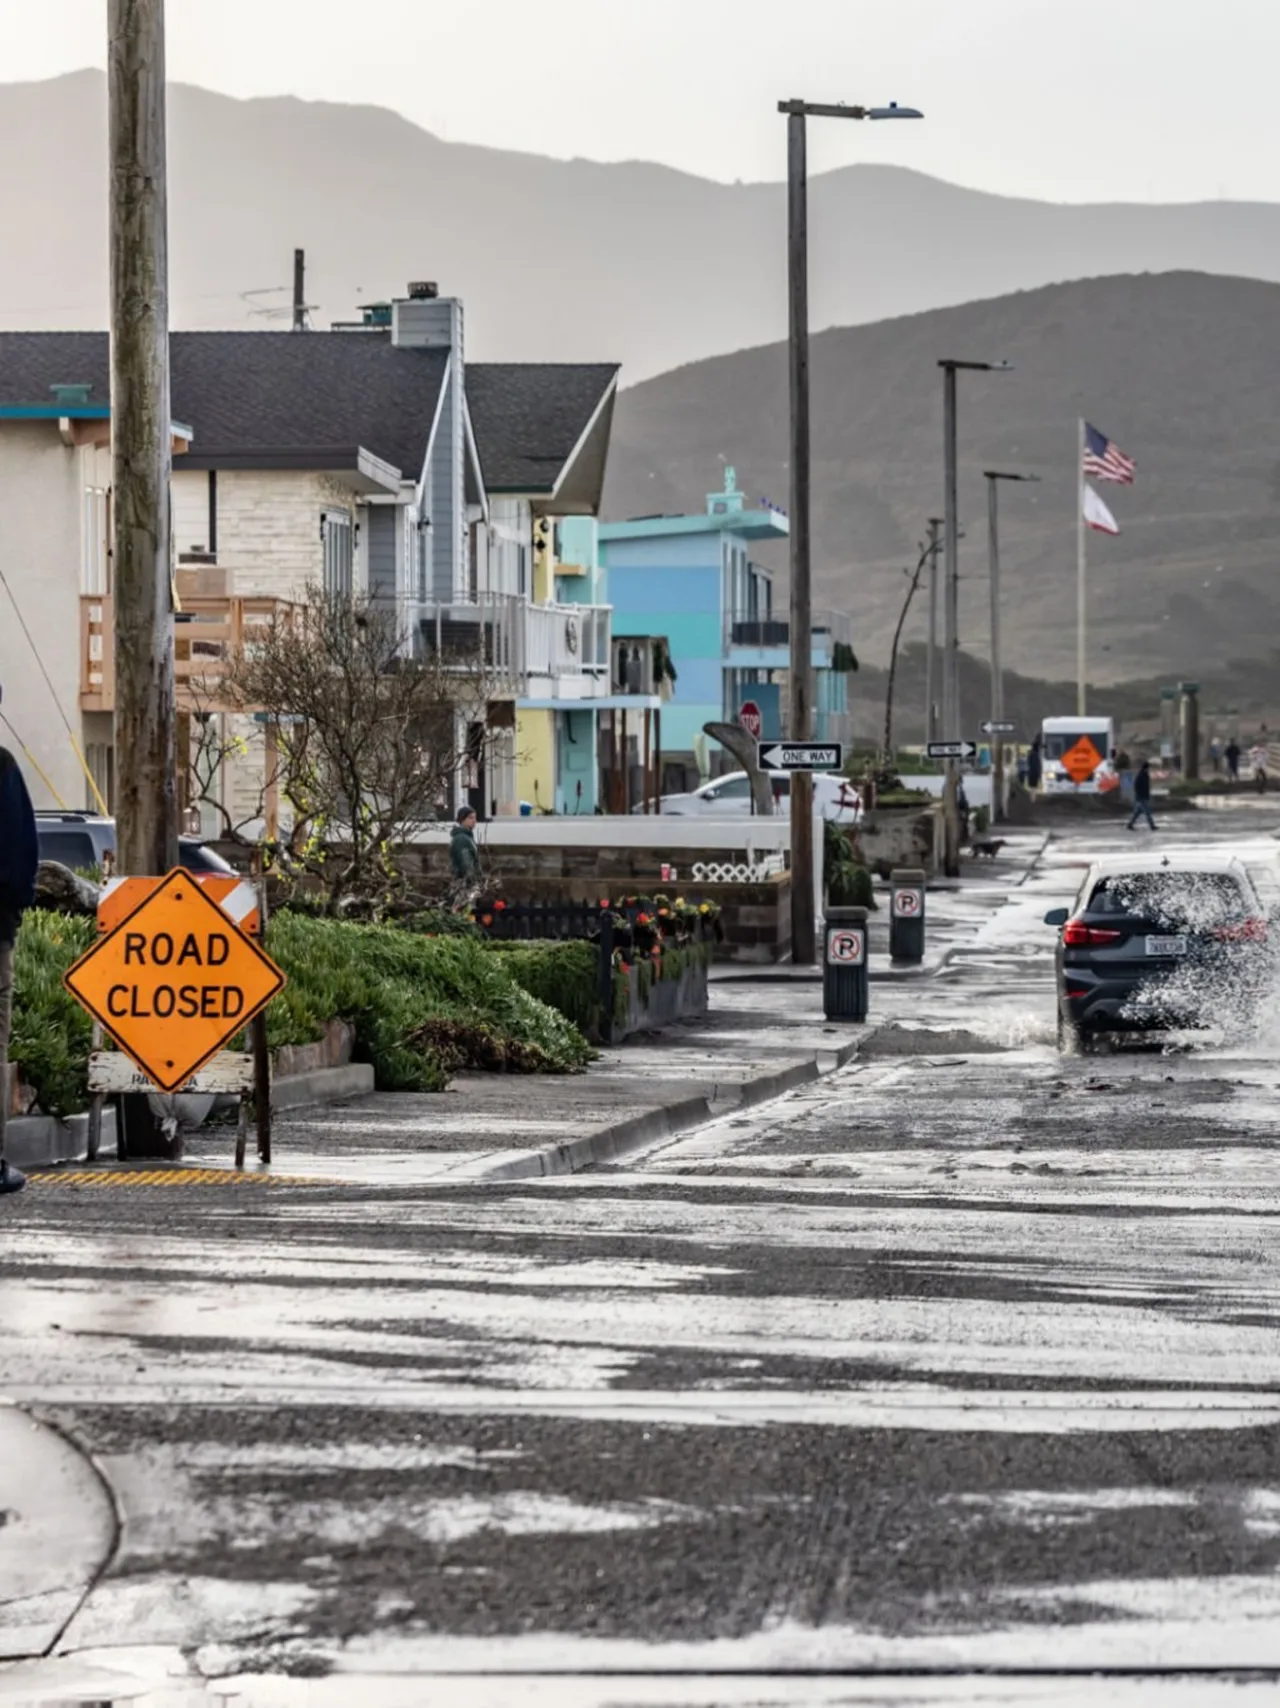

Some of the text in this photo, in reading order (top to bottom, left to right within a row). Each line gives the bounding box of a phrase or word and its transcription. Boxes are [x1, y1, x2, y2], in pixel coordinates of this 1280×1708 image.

[740, 713, 760, 730] STOP
[783, 751, 833, 762] ONE WAY
[124, 932, 230, 966] ROAD
[106, 984, 244, 1018] CLOSED
